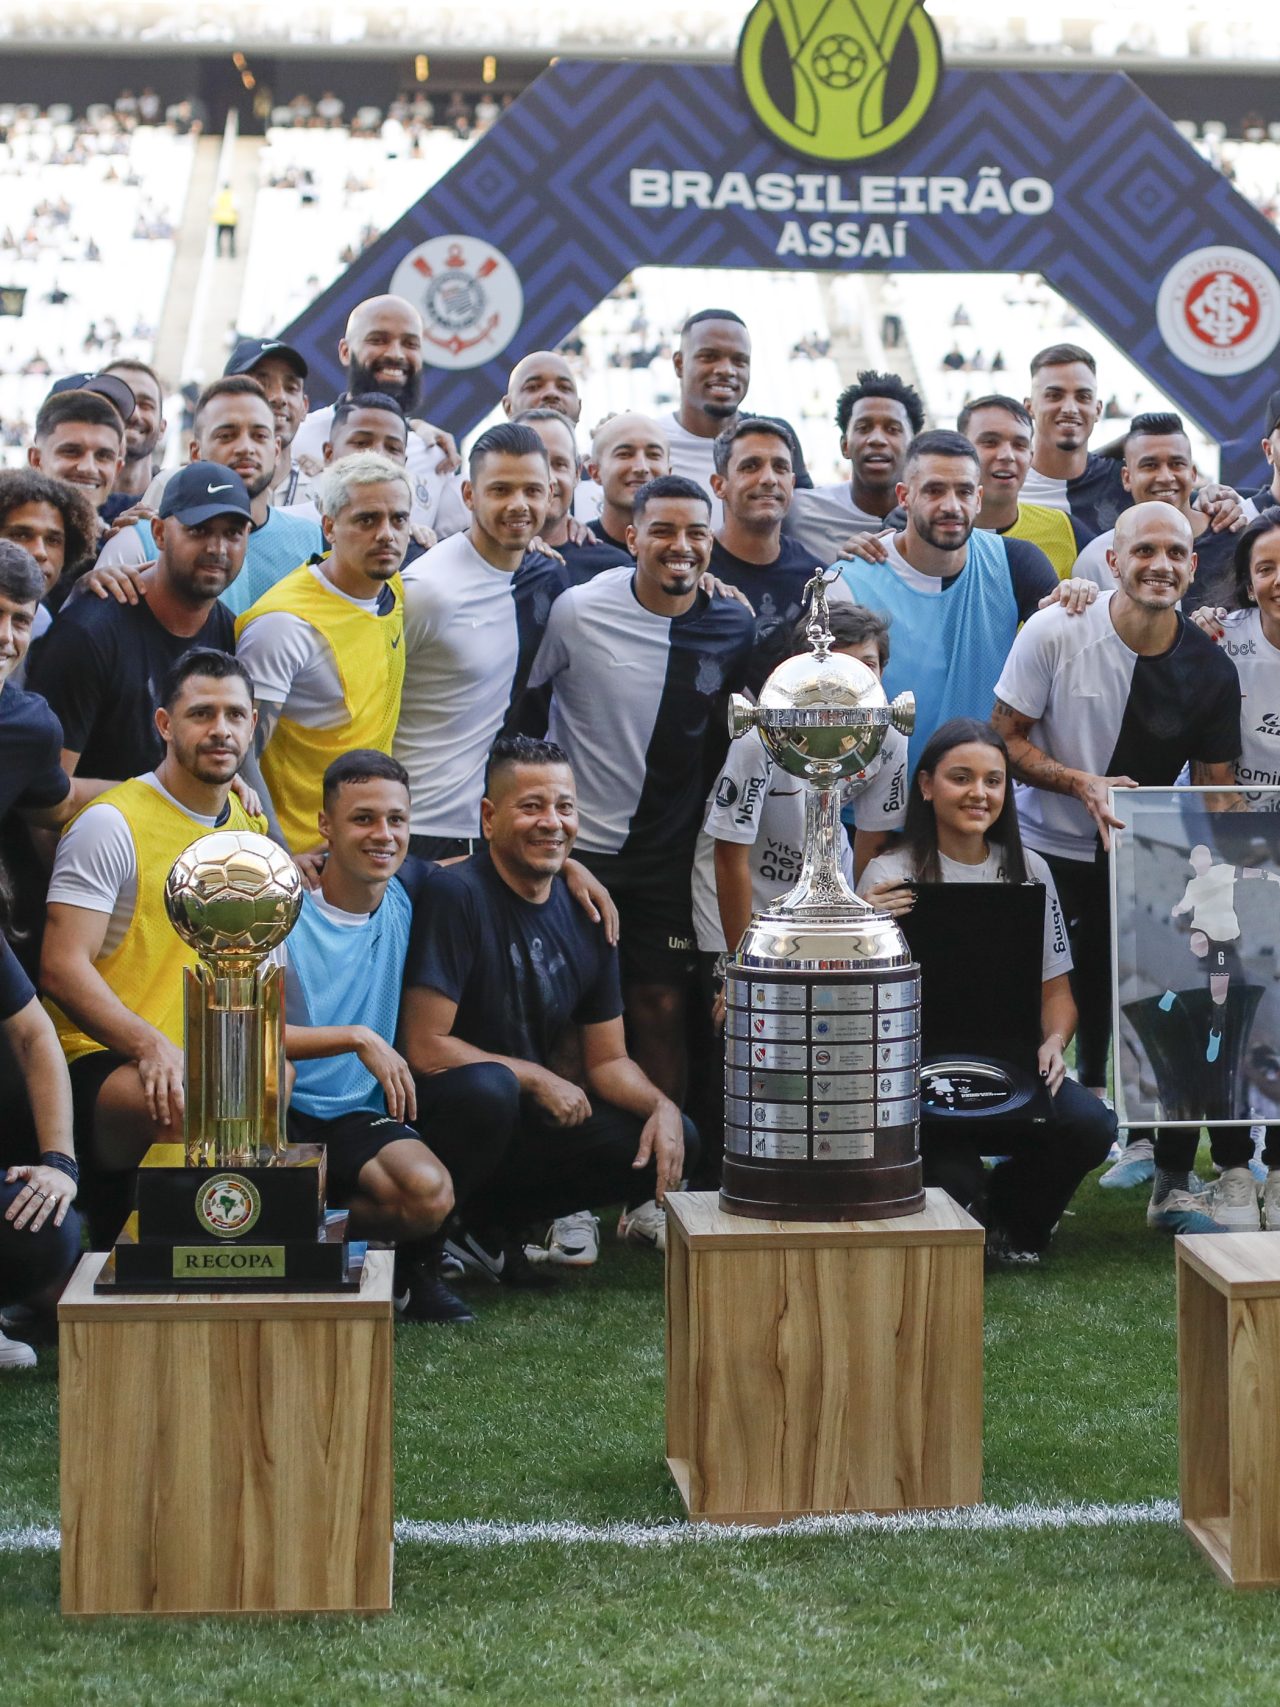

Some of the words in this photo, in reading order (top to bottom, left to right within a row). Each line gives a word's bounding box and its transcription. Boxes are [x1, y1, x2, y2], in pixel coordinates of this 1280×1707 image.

[629, 166, 1054, 215] BRASILEIRÃO
[776, 220, 908, 258] ASSAÍ
[739, 777, 766, 815] bmg
[883, 774, 902, 812] bmg
[1053, 912, 1066, 953] bmg
[1217, 951, 1225, 965] 6
[186, 1254, 274, 1268] RECOPA
